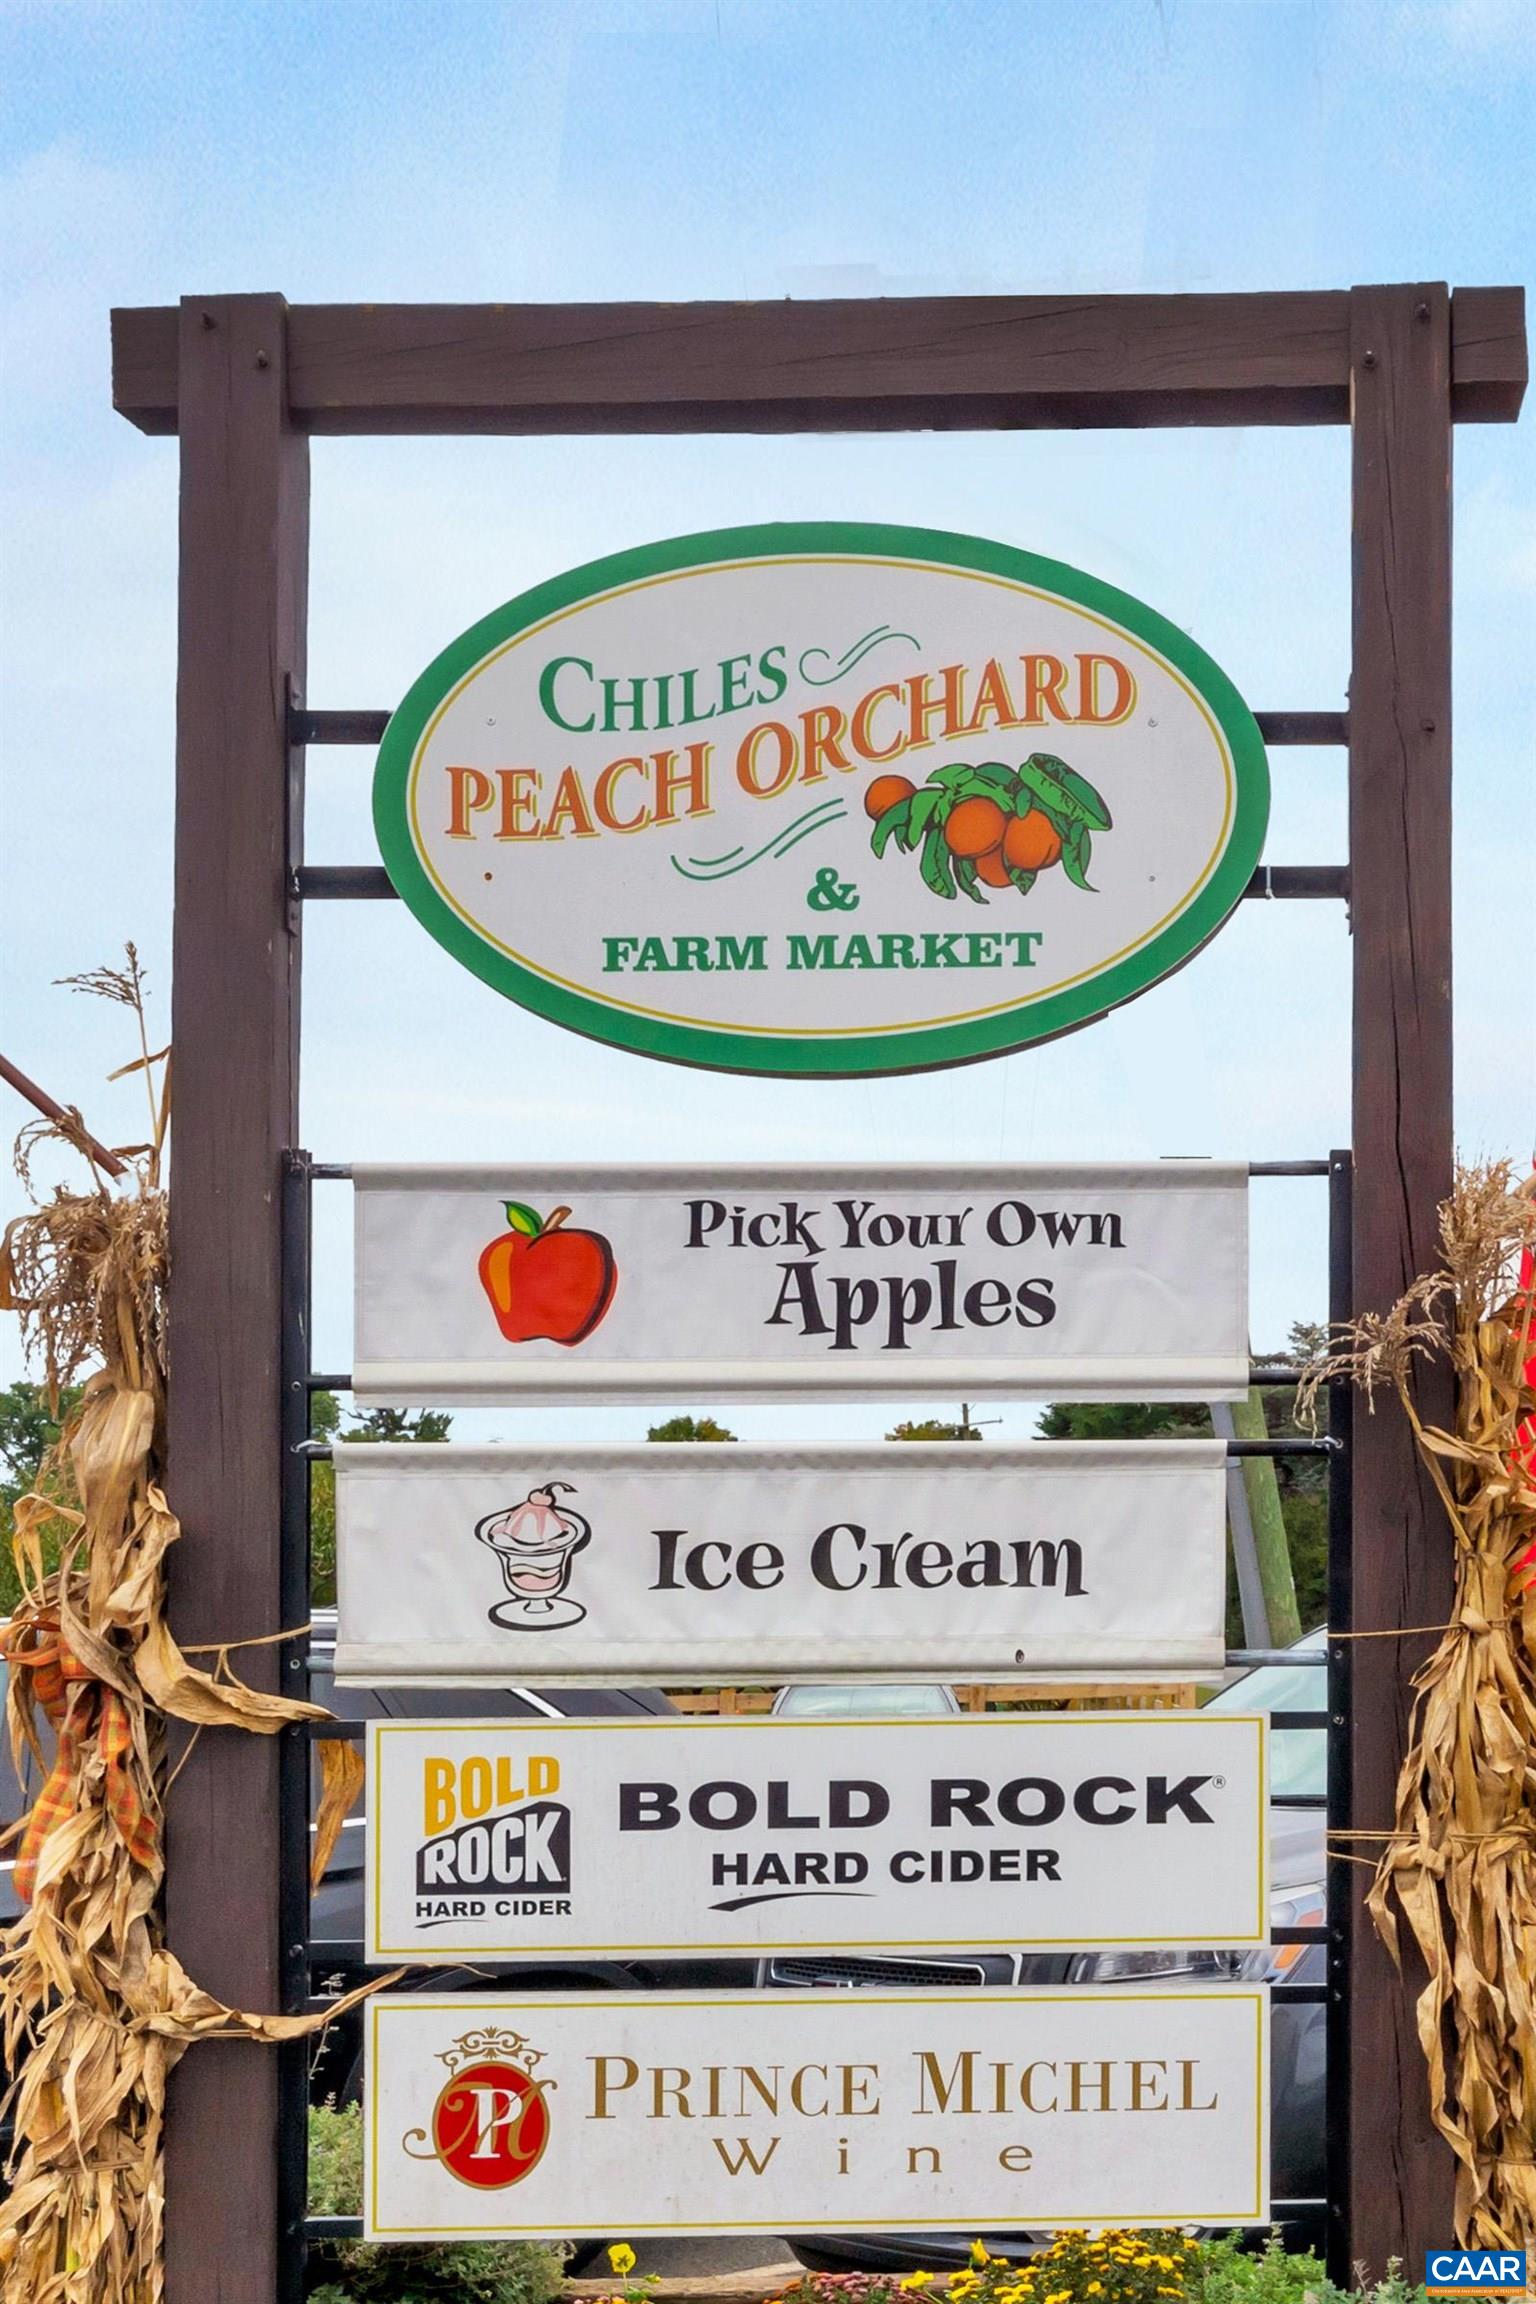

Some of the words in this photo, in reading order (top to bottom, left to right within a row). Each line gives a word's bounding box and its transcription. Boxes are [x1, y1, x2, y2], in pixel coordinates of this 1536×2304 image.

[538, 646, 788, 735] CHILES
[445, 742, 715, 841] PEACH
[736, 653, 1139, 798] ORCHARD
[807, 868, 860, 911] &
[602, 936, 768, 972] FARM
[786, 933, 1042, 970] MARKET
[683, 1200, 826, 1256] Pick
[834, 1200, 973, 1249] Your
[986, 1201, 1126, 1249] Own
[764, 1260, 1056, 1350] Apples
[648, 1530, 784, 1590] Ice
[811, 1524, 1089, 1597] Cream
[424, 1756, 560, 1836] BOLD
[619, 1779, 890, 1831] BOLD
[424, 1811, 562, 1883] ROCK
[712, 1852, 868, 1886] HARD
[890, 1849, 1062, 1883] CIDER
[416, 1902, 485, 1917] HARD
[495, 1900, 572, 1916] CIDER
[586, 2056, 879, 2120] PRINCE
[912, 2051, 1218, 2114] MICHEL
[713, 2137, 1033, 2175] Wine
